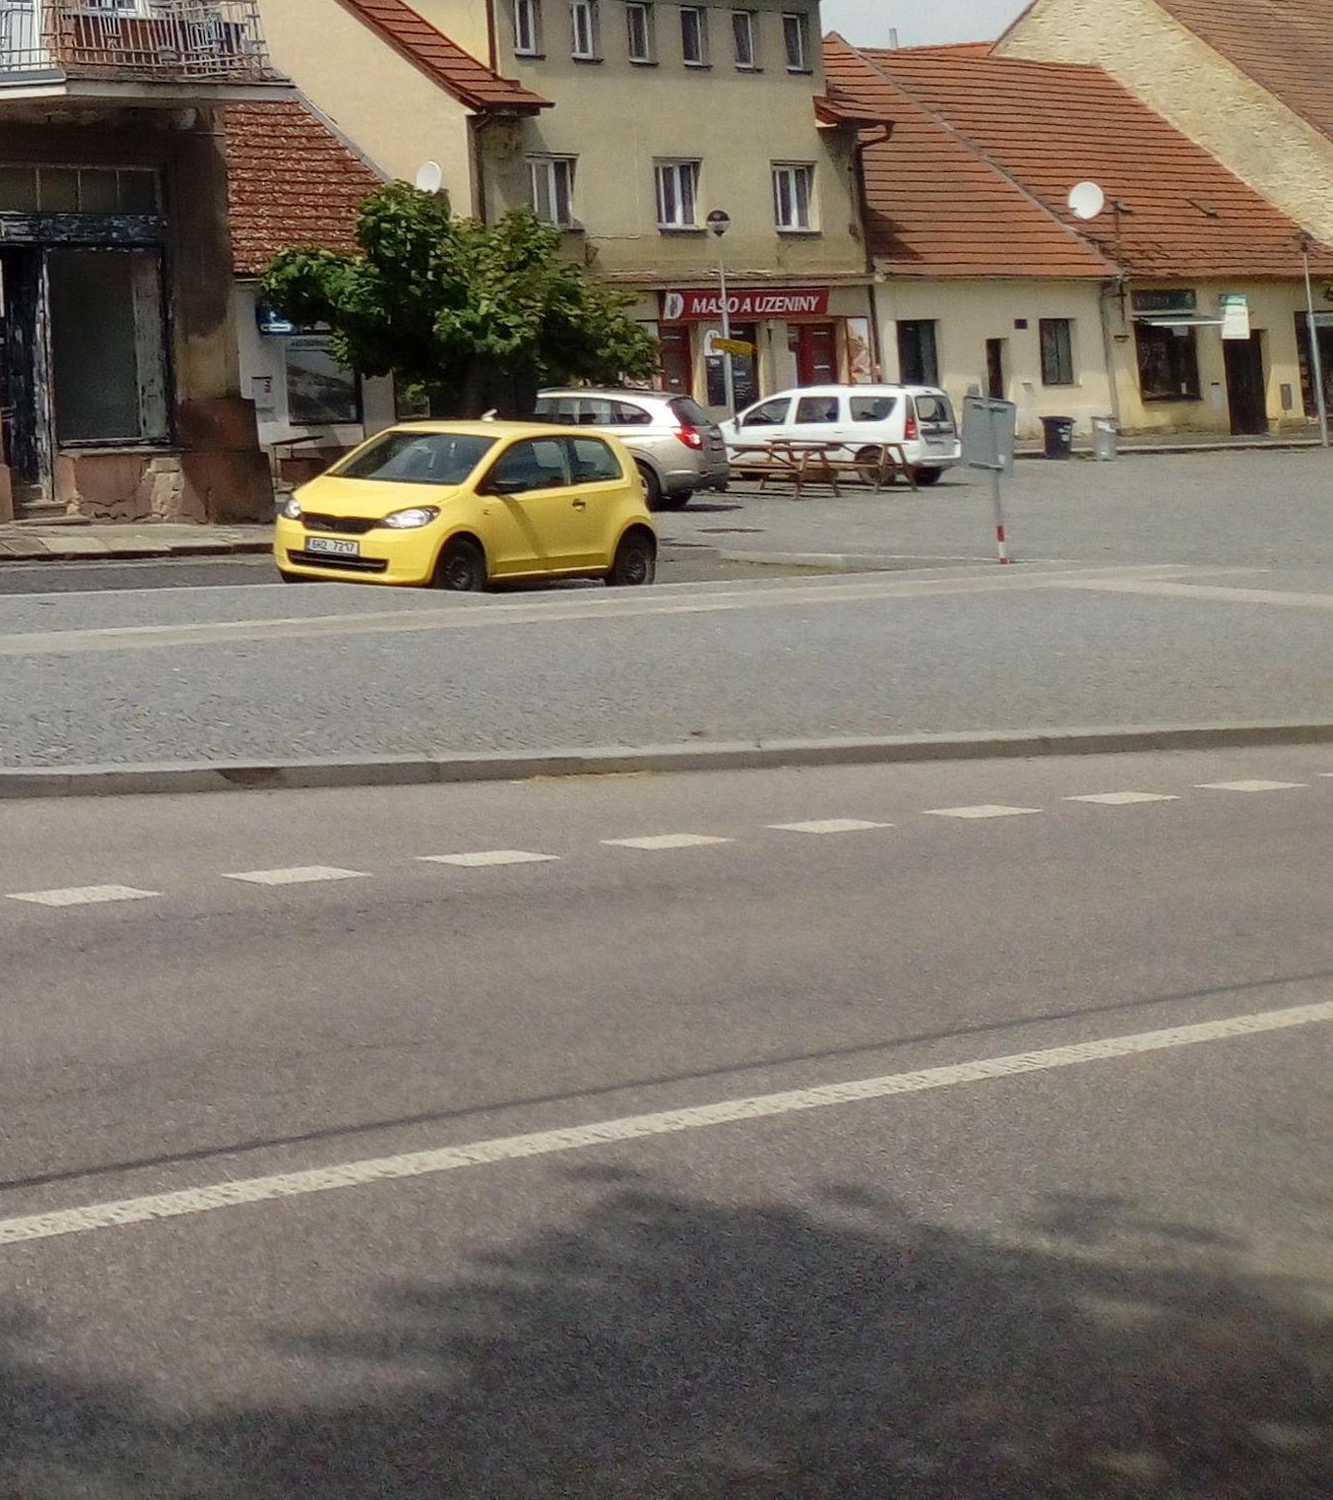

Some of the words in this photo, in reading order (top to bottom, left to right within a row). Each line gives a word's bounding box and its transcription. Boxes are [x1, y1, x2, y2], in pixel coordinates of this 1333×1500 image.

[692, 296, 739, 314] MASO
[741, 297, 752, 313] A
[754, 295, 820, 313] UZENINY
